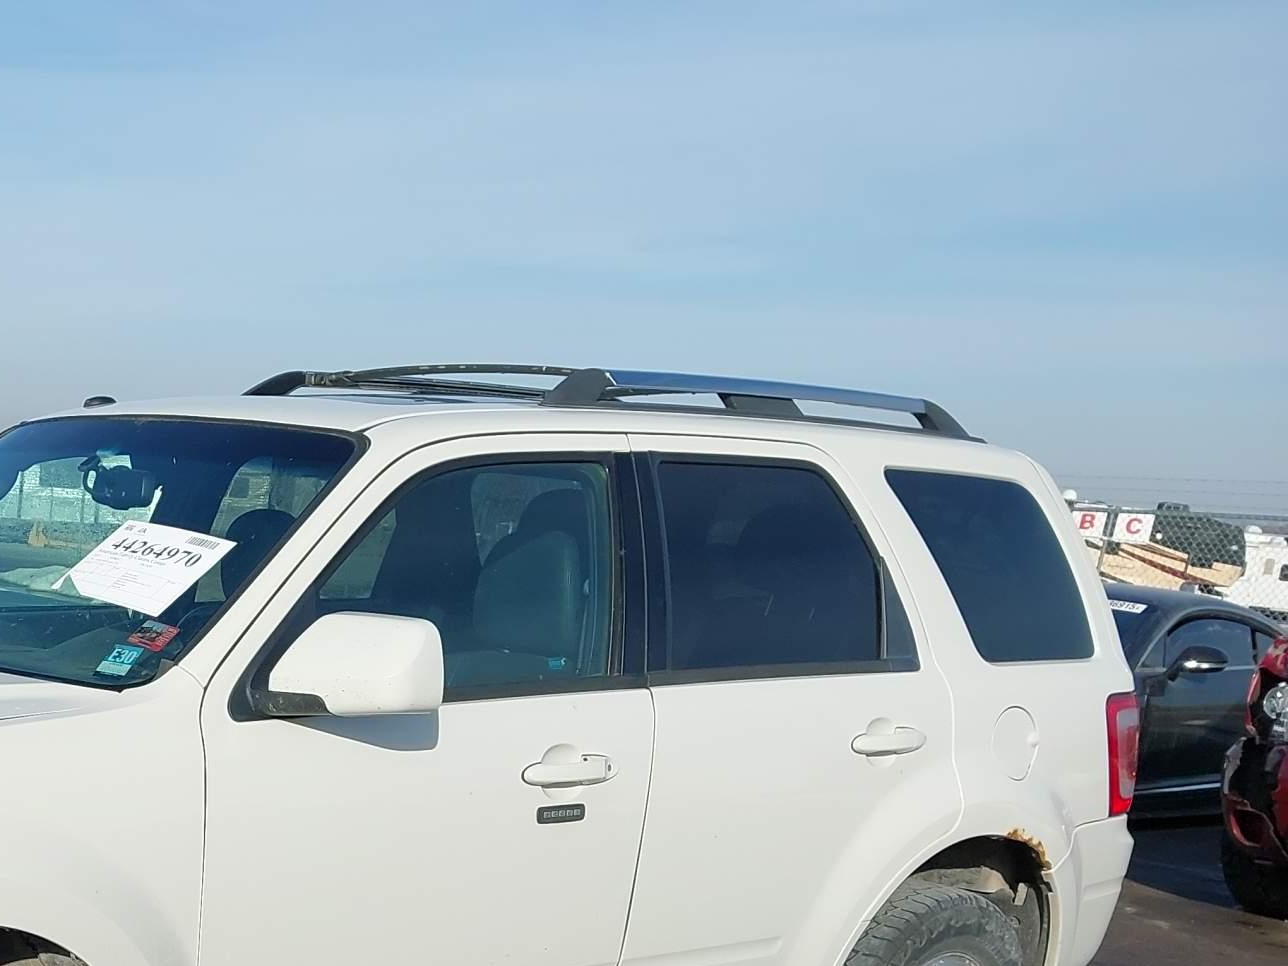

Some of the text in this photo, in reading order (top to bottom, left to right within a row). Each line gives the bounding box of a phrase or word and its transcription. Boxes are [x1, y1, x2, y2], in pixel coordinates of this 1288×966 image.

[1079, 513, 1096, 529] B
[1126, 517, 1144, 534] C
[111, 537, 203, 568] 44264970
[108, 648, 138, 664] E30
